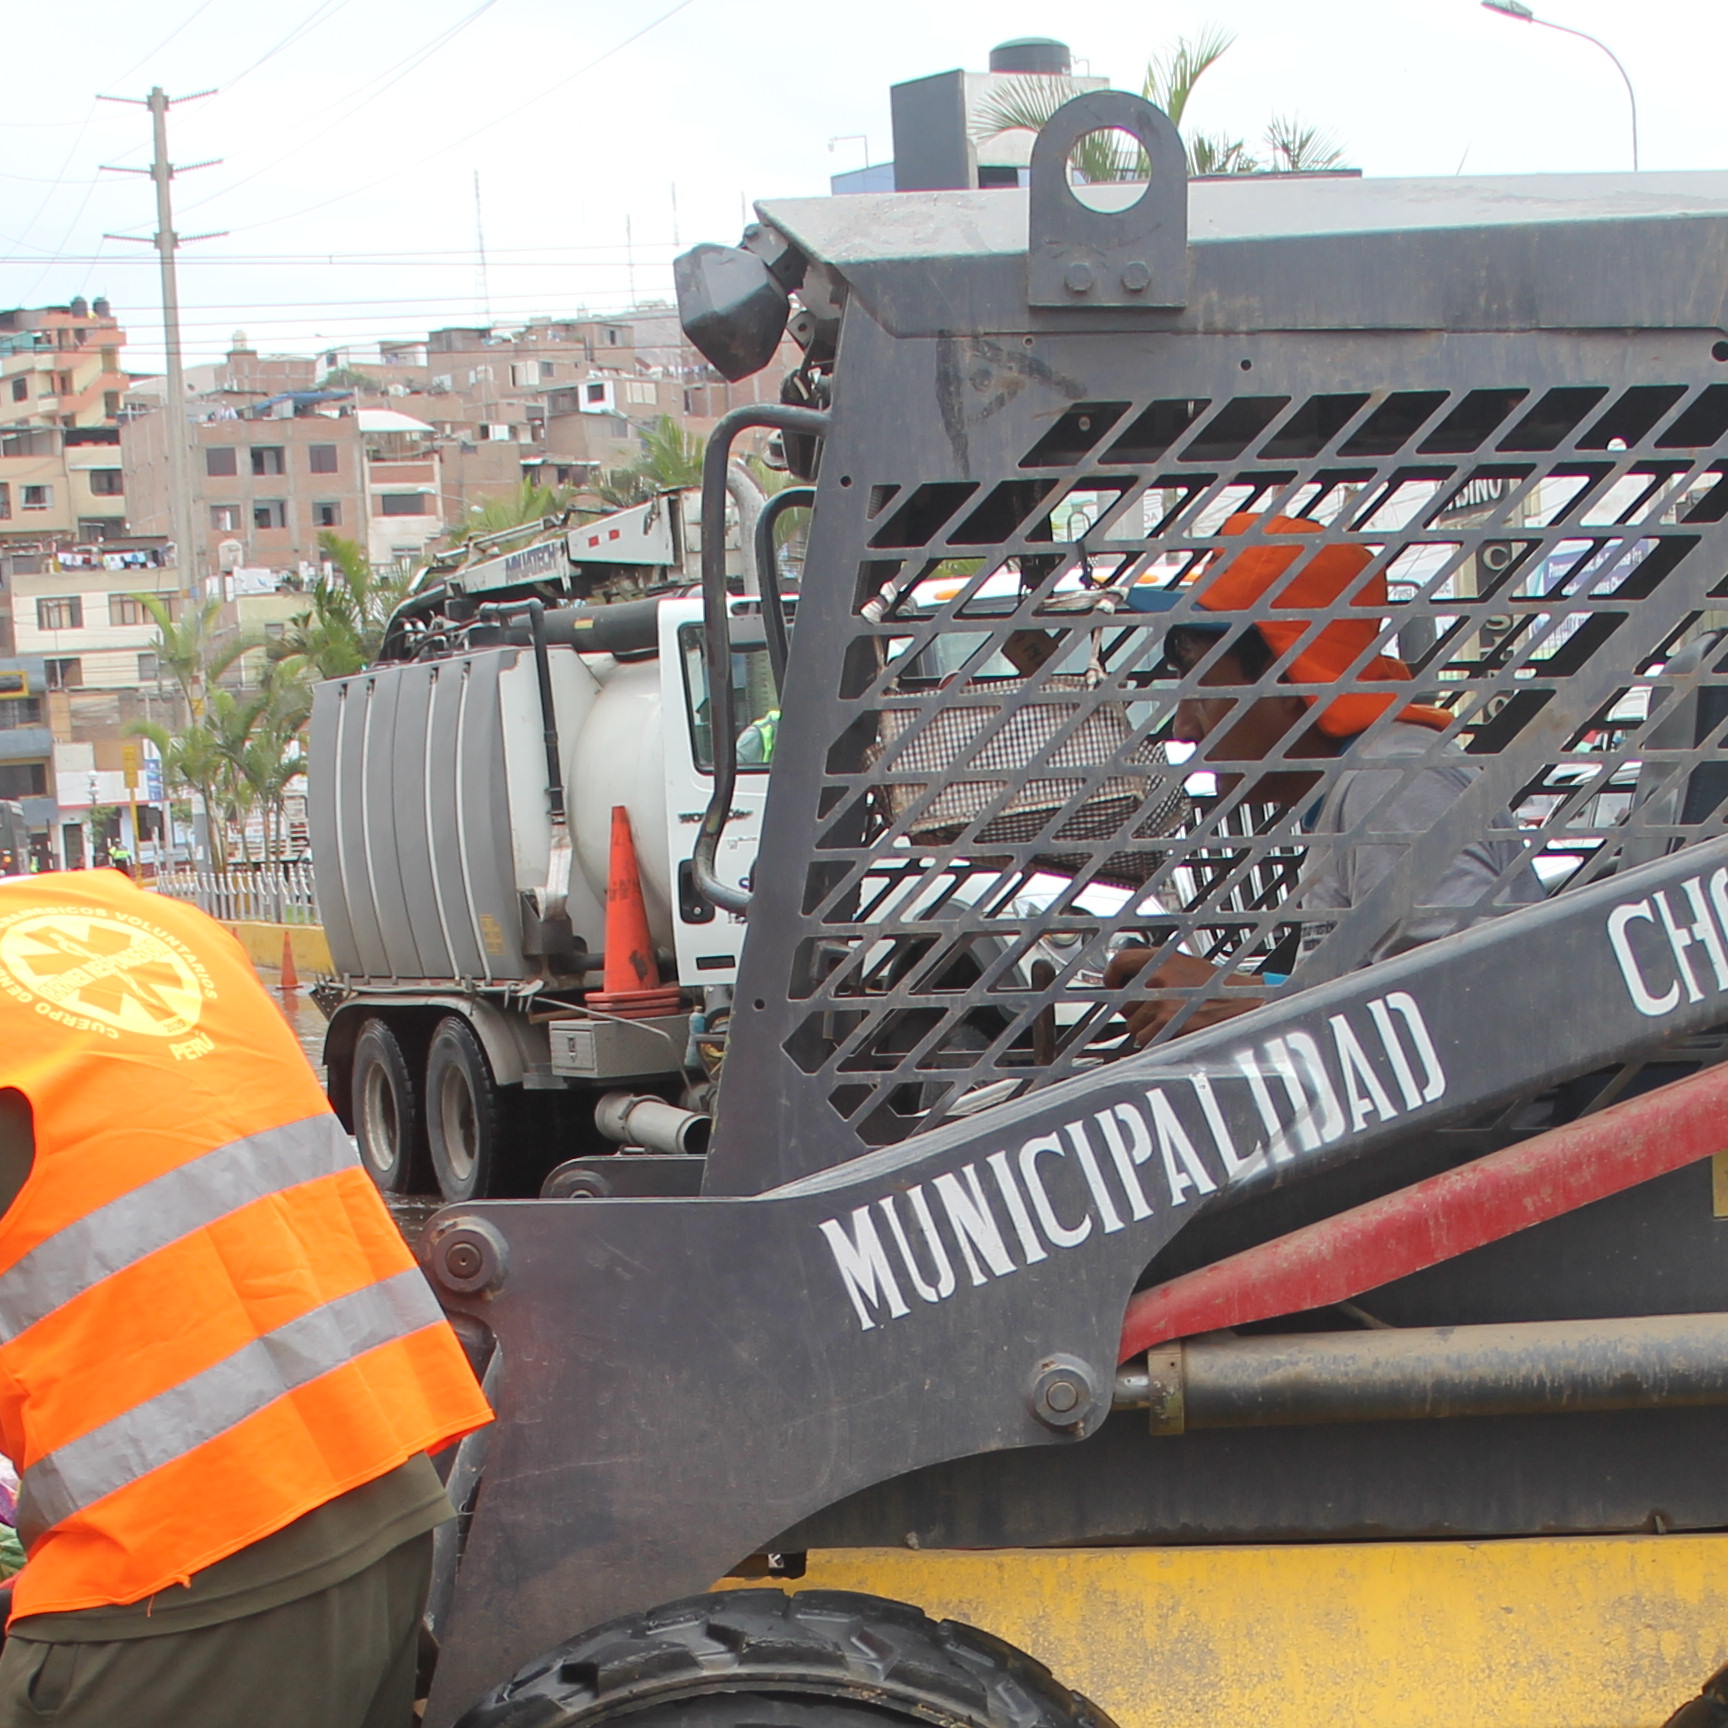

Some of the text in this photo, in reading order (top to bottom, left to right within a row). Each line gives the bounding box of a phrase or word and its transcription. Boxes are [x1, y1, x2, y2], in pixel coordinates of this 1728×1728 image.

[34, 1002, 120, 1040] CUERPO
[115, 911, 218, 1000] VOLUNTARIOS
[818, 991, 1447, 1332] MUNICIPALIDAD
